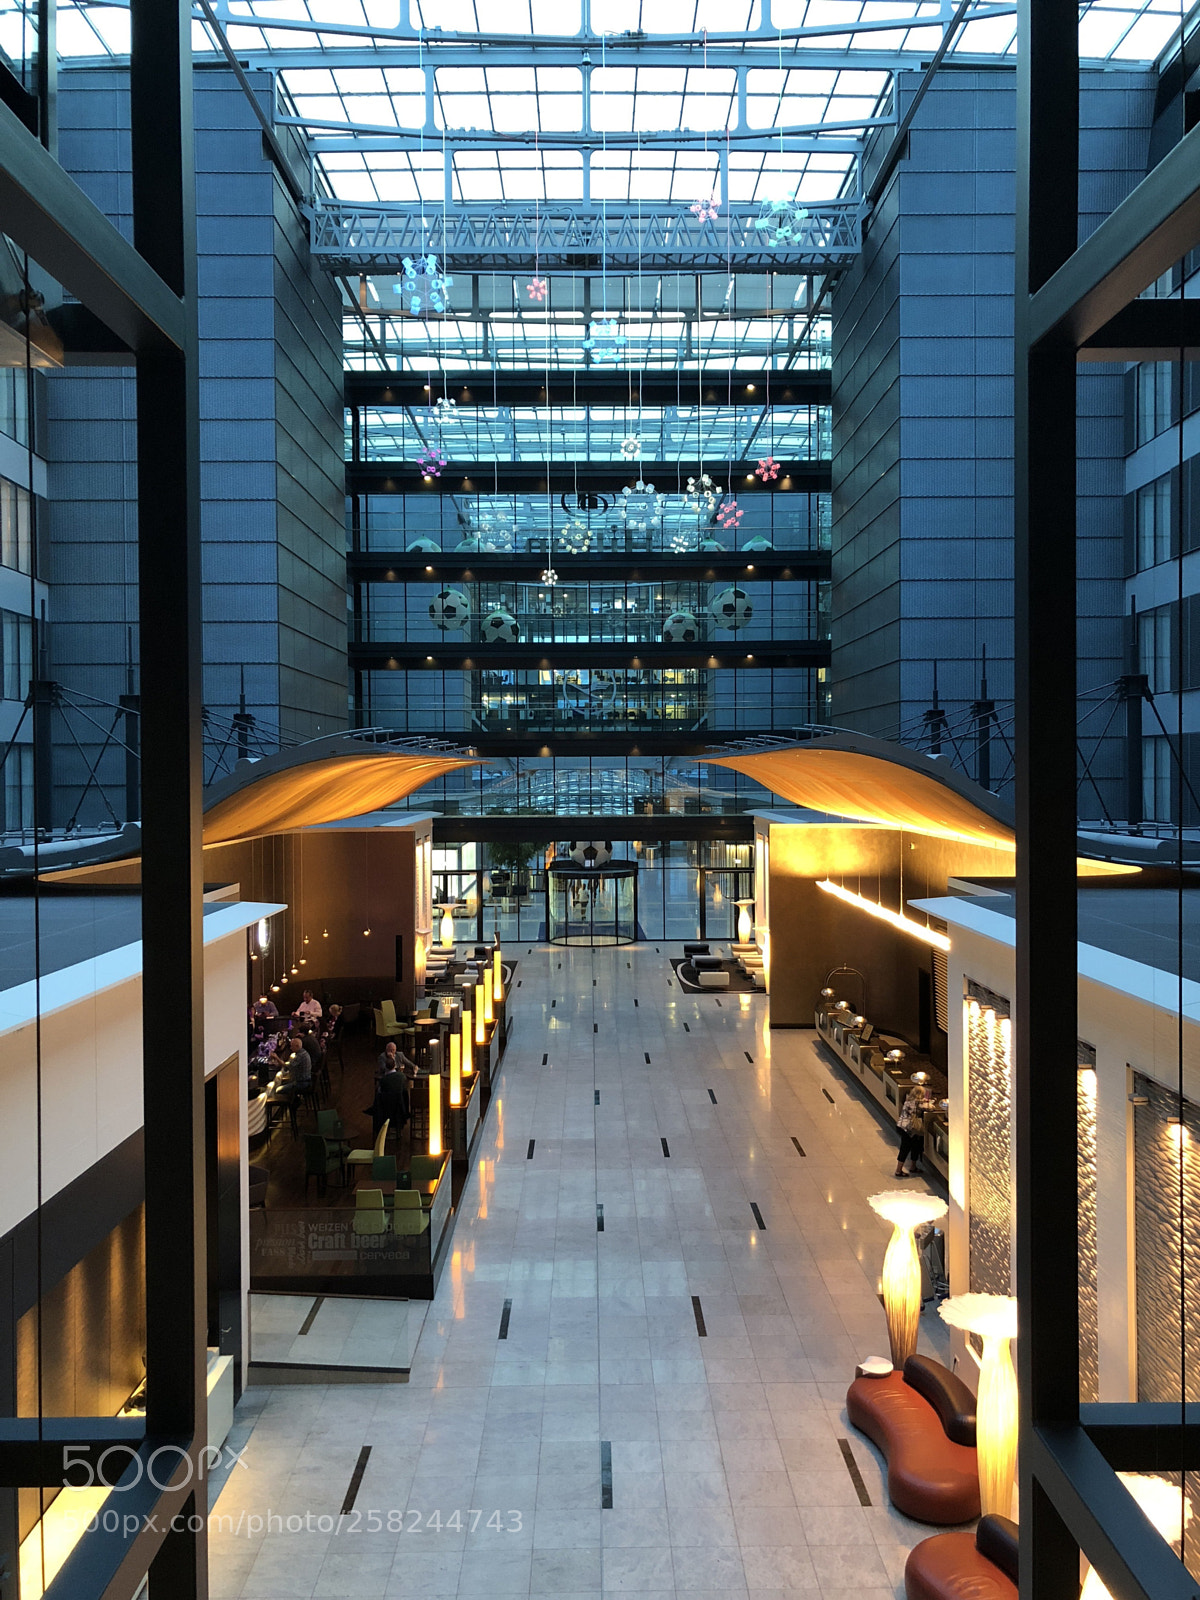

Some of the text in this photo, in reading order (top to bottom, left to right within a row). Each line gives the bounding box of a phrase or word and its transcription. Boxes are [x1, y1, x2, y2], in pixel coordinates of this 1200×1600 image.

[307, 1222, 349, 1232] WEIZEN
[307, 1233, 346, 1249] Craft
[351, 1233, 387, 1249] beer
